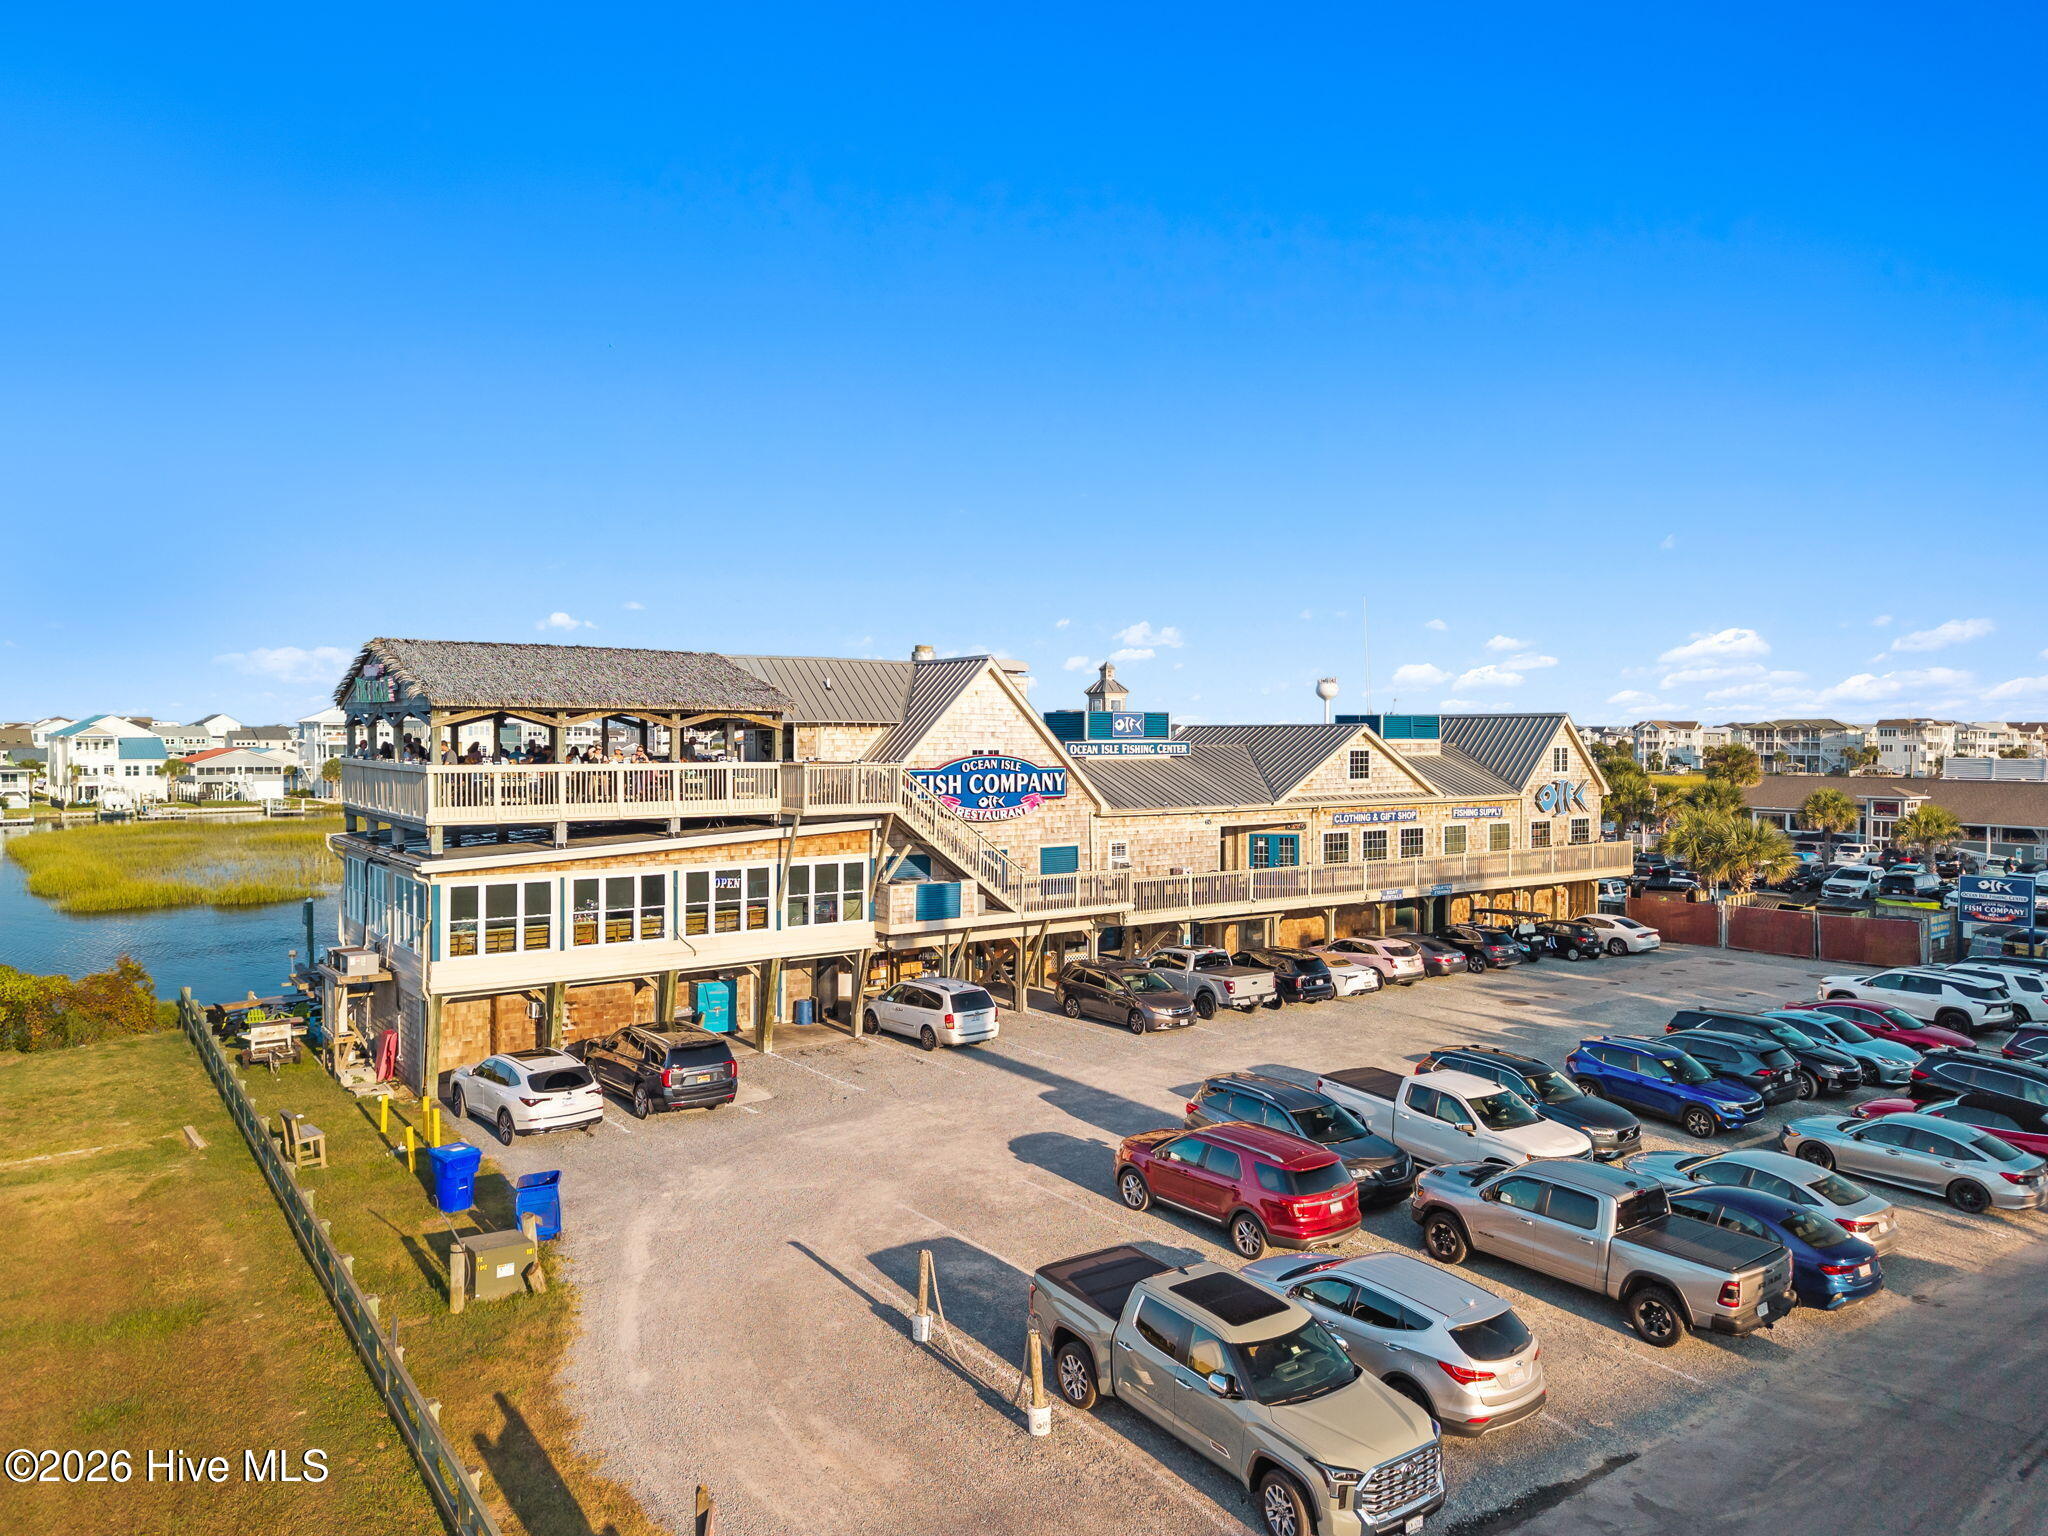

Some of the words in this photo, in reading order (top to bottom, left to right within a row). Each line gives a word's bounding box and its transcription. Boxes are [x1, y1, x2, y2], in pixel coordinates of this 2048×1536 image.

[1070, 744, 1099, 755] OCEAN
[1101, 744, 1120, 755] ISLE
[1122, 744, 1155, 754] FISHING
[1157, 743, 1188, 754] CENTER
[961, 760, 998, 773] OCEAN
[1000, 759, 1022, 772] ISLE
[968, 772, 1066, 795] COMPANY
[956, 805, 1028, 822] RESTAURANT
[1334, 812, 1371, 824] CLOTHING
[1372, 812, 1379, 821] &
[1380, 811, 1397, 821] GIFT
[1397, 810, 1416, 820] SHOP
[1453, 808, 1479, 817] FISHING
[1479, 807, 1503, 816] SUPPLY
[714, 877, 741, 889] OPEN
[2008, 894, 2027, 902] CENTER
[1964, 904, 1982, 912] FISH
[1984, 905, 2025, 916] COMPANY
[1758, 1273, 1782, 1290] RAM
